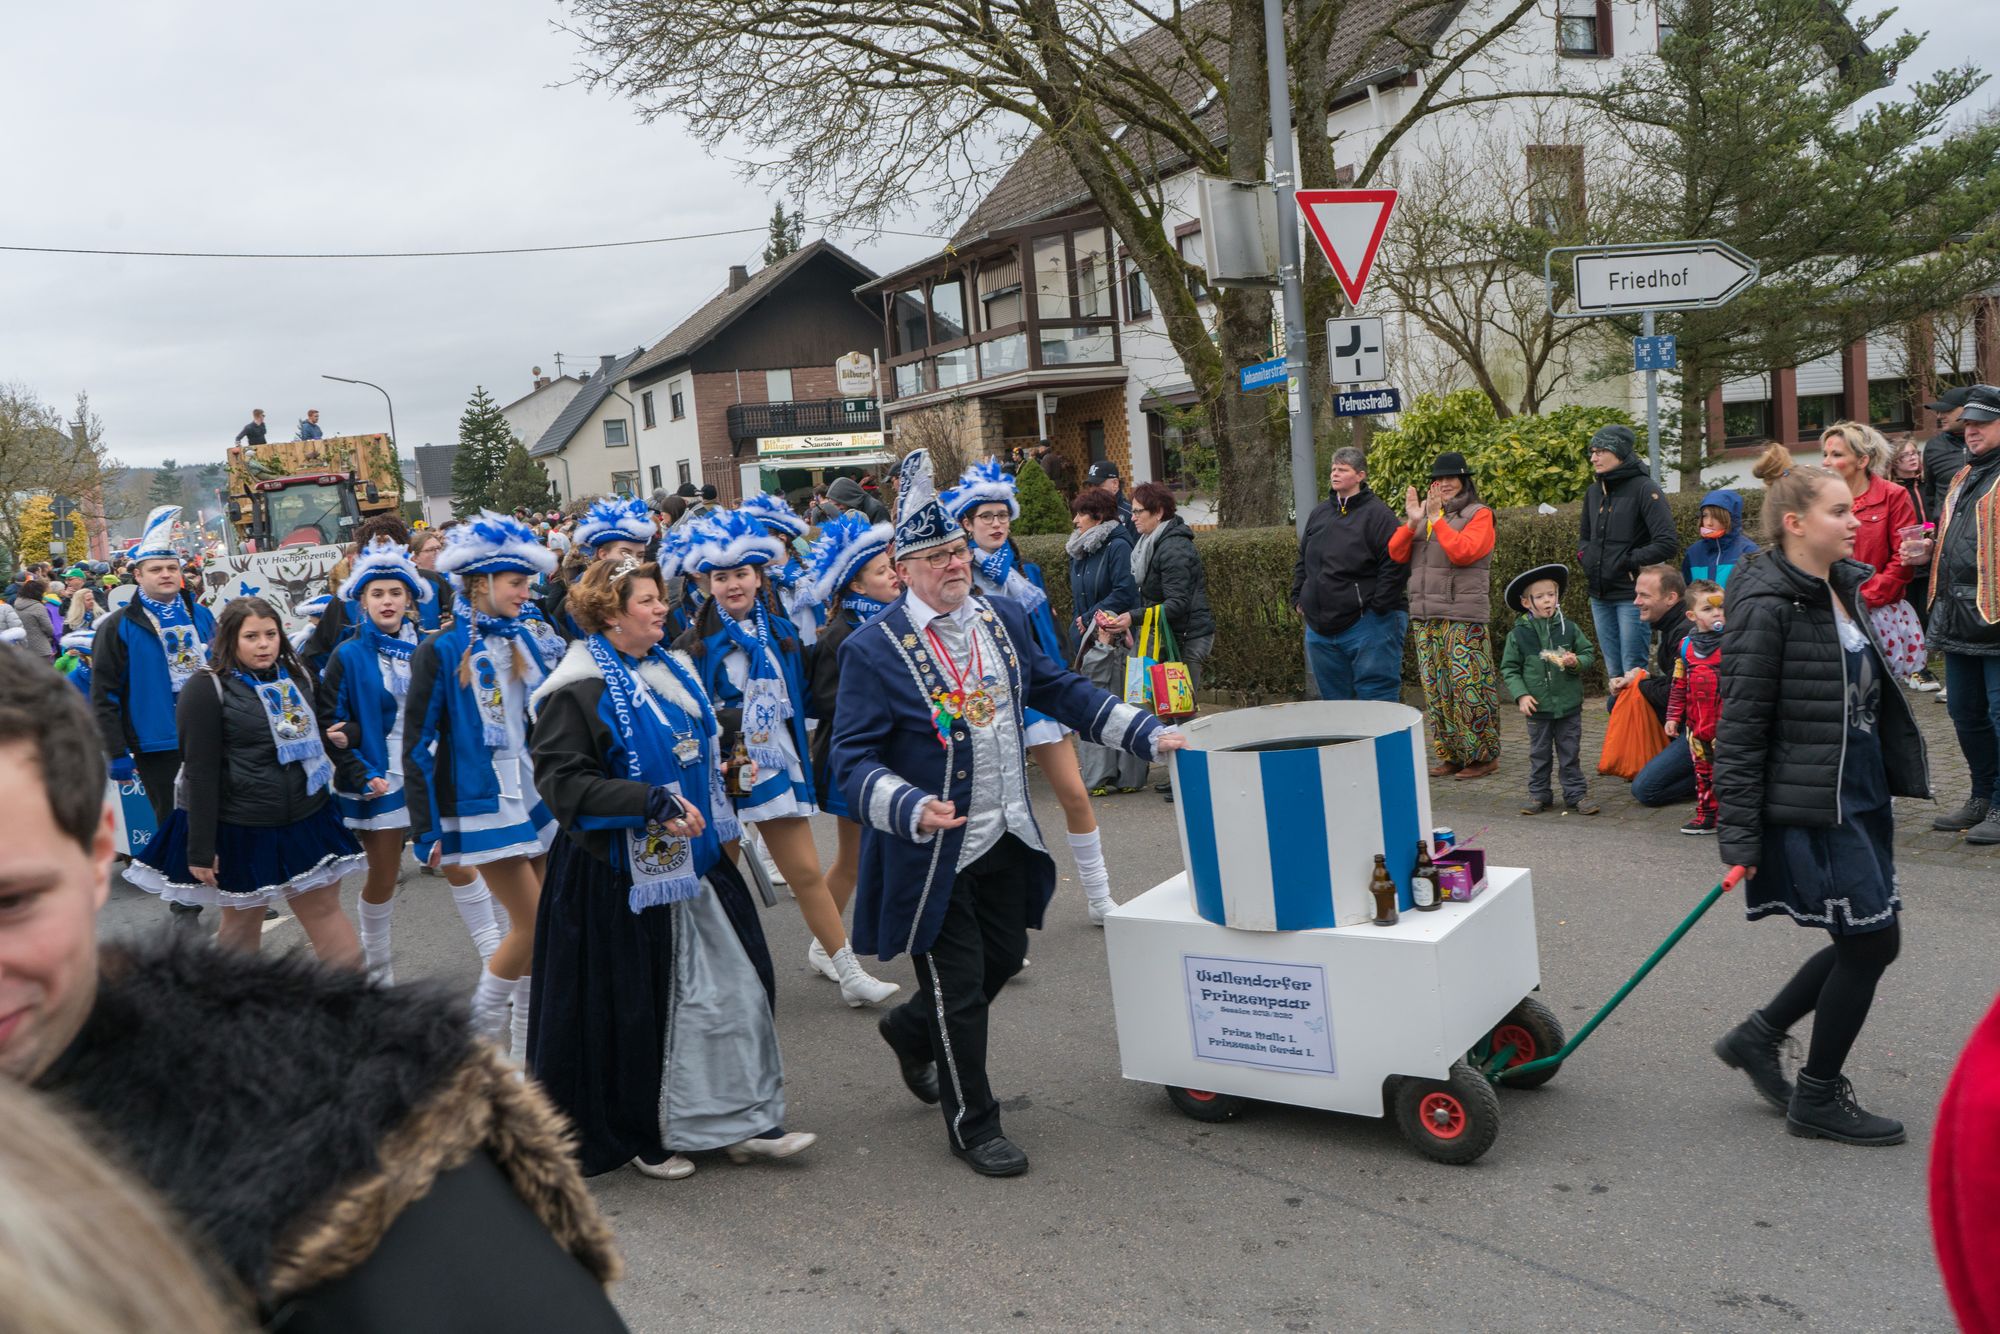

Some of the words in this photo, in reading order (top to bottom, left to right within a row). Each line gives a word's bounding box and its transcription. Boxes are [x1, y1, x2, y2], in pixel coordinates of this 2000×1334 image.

[1608, 267, 1689, 291] Friedhof
[1243, 361, 1288, 386] Johanniterstraß
[1338, 392, 1394, 412] Petrusstraße
[256, 557, 269, 566] KV
[271, 550, 337, 564] Hochprozentig
[1195, 969, 1312, 991] Wallendorfer
[1200, 988, 1311, 1010] Prinzenpaar
[1221, 1027, 1252, 1039] Prinz
[1208, 1037, 1267, 1053] Prinzessin
[1269, 1044, 1303, 1056] Gerda
